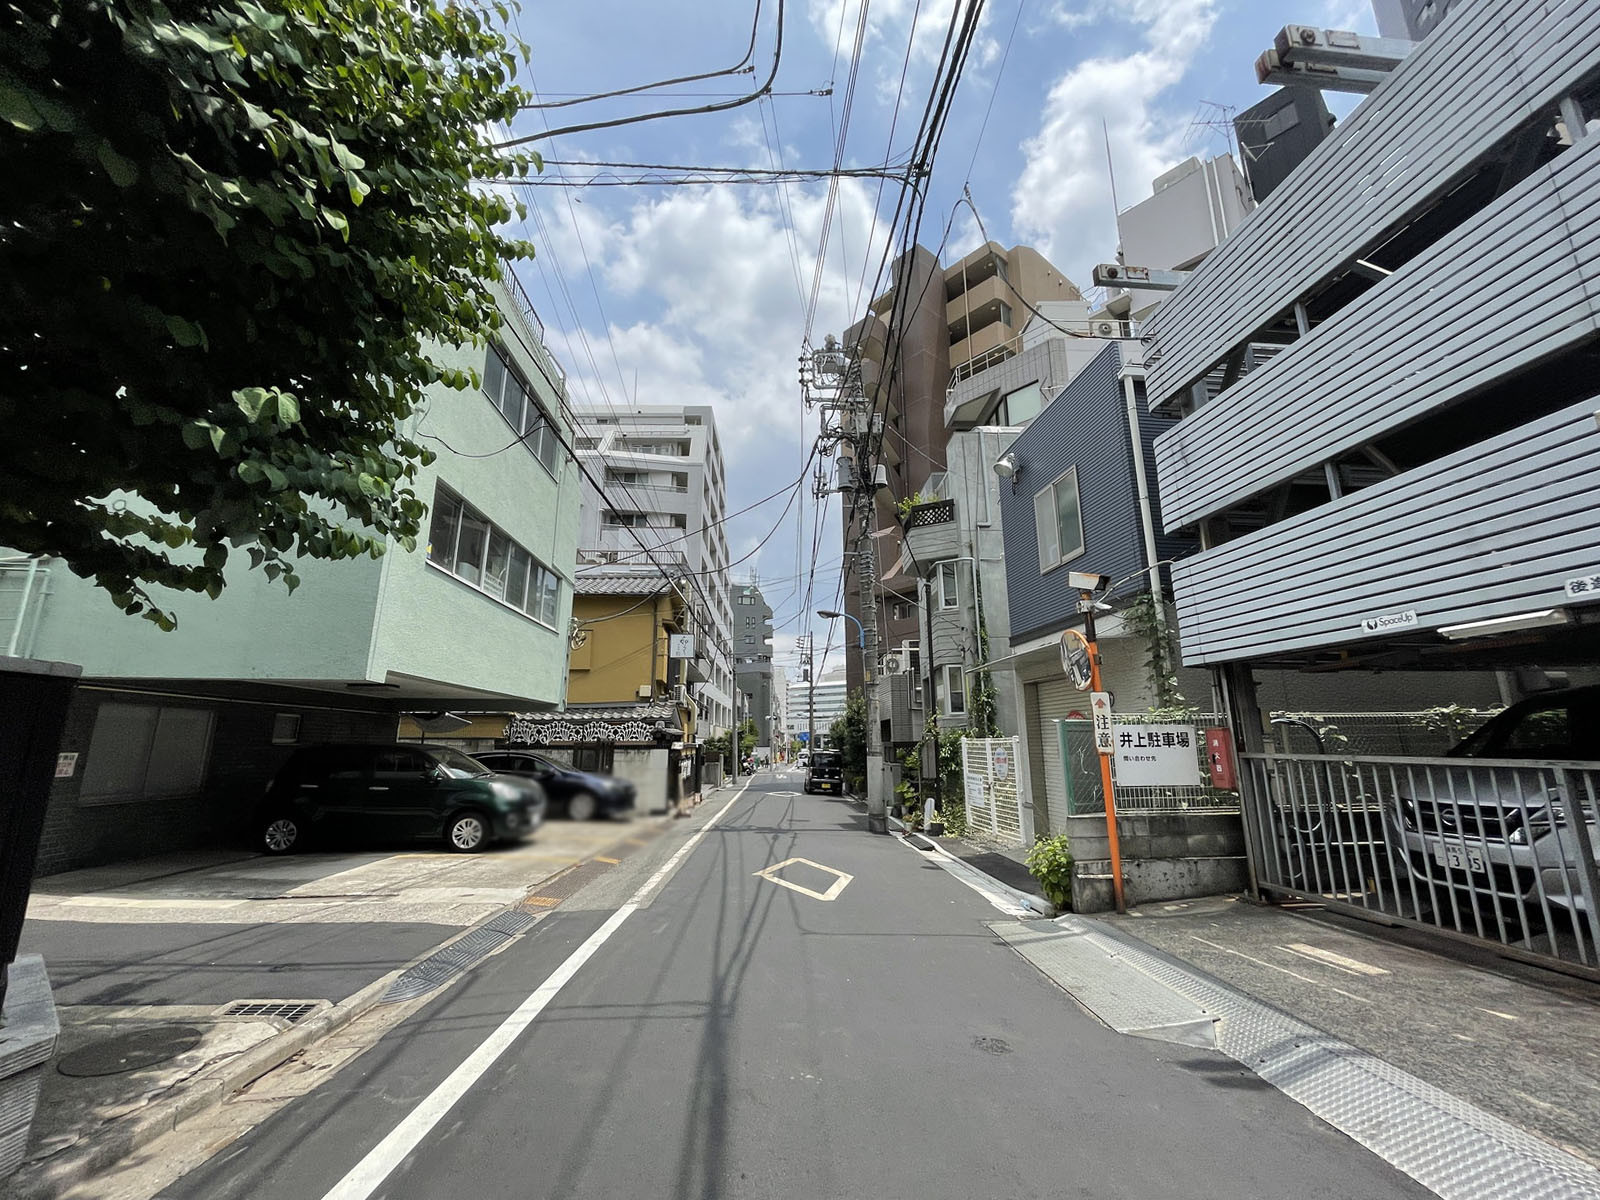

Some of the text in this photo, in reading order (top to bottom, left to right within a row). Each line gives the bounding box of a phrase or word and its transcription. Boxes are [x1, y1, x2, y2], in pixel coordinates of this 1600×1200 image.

[1378, 612, 1413, 628] SpaceUp
[1096, 714, 1112, 748] 注意
[1119, 731, 1190, 749] 井上駐車場
